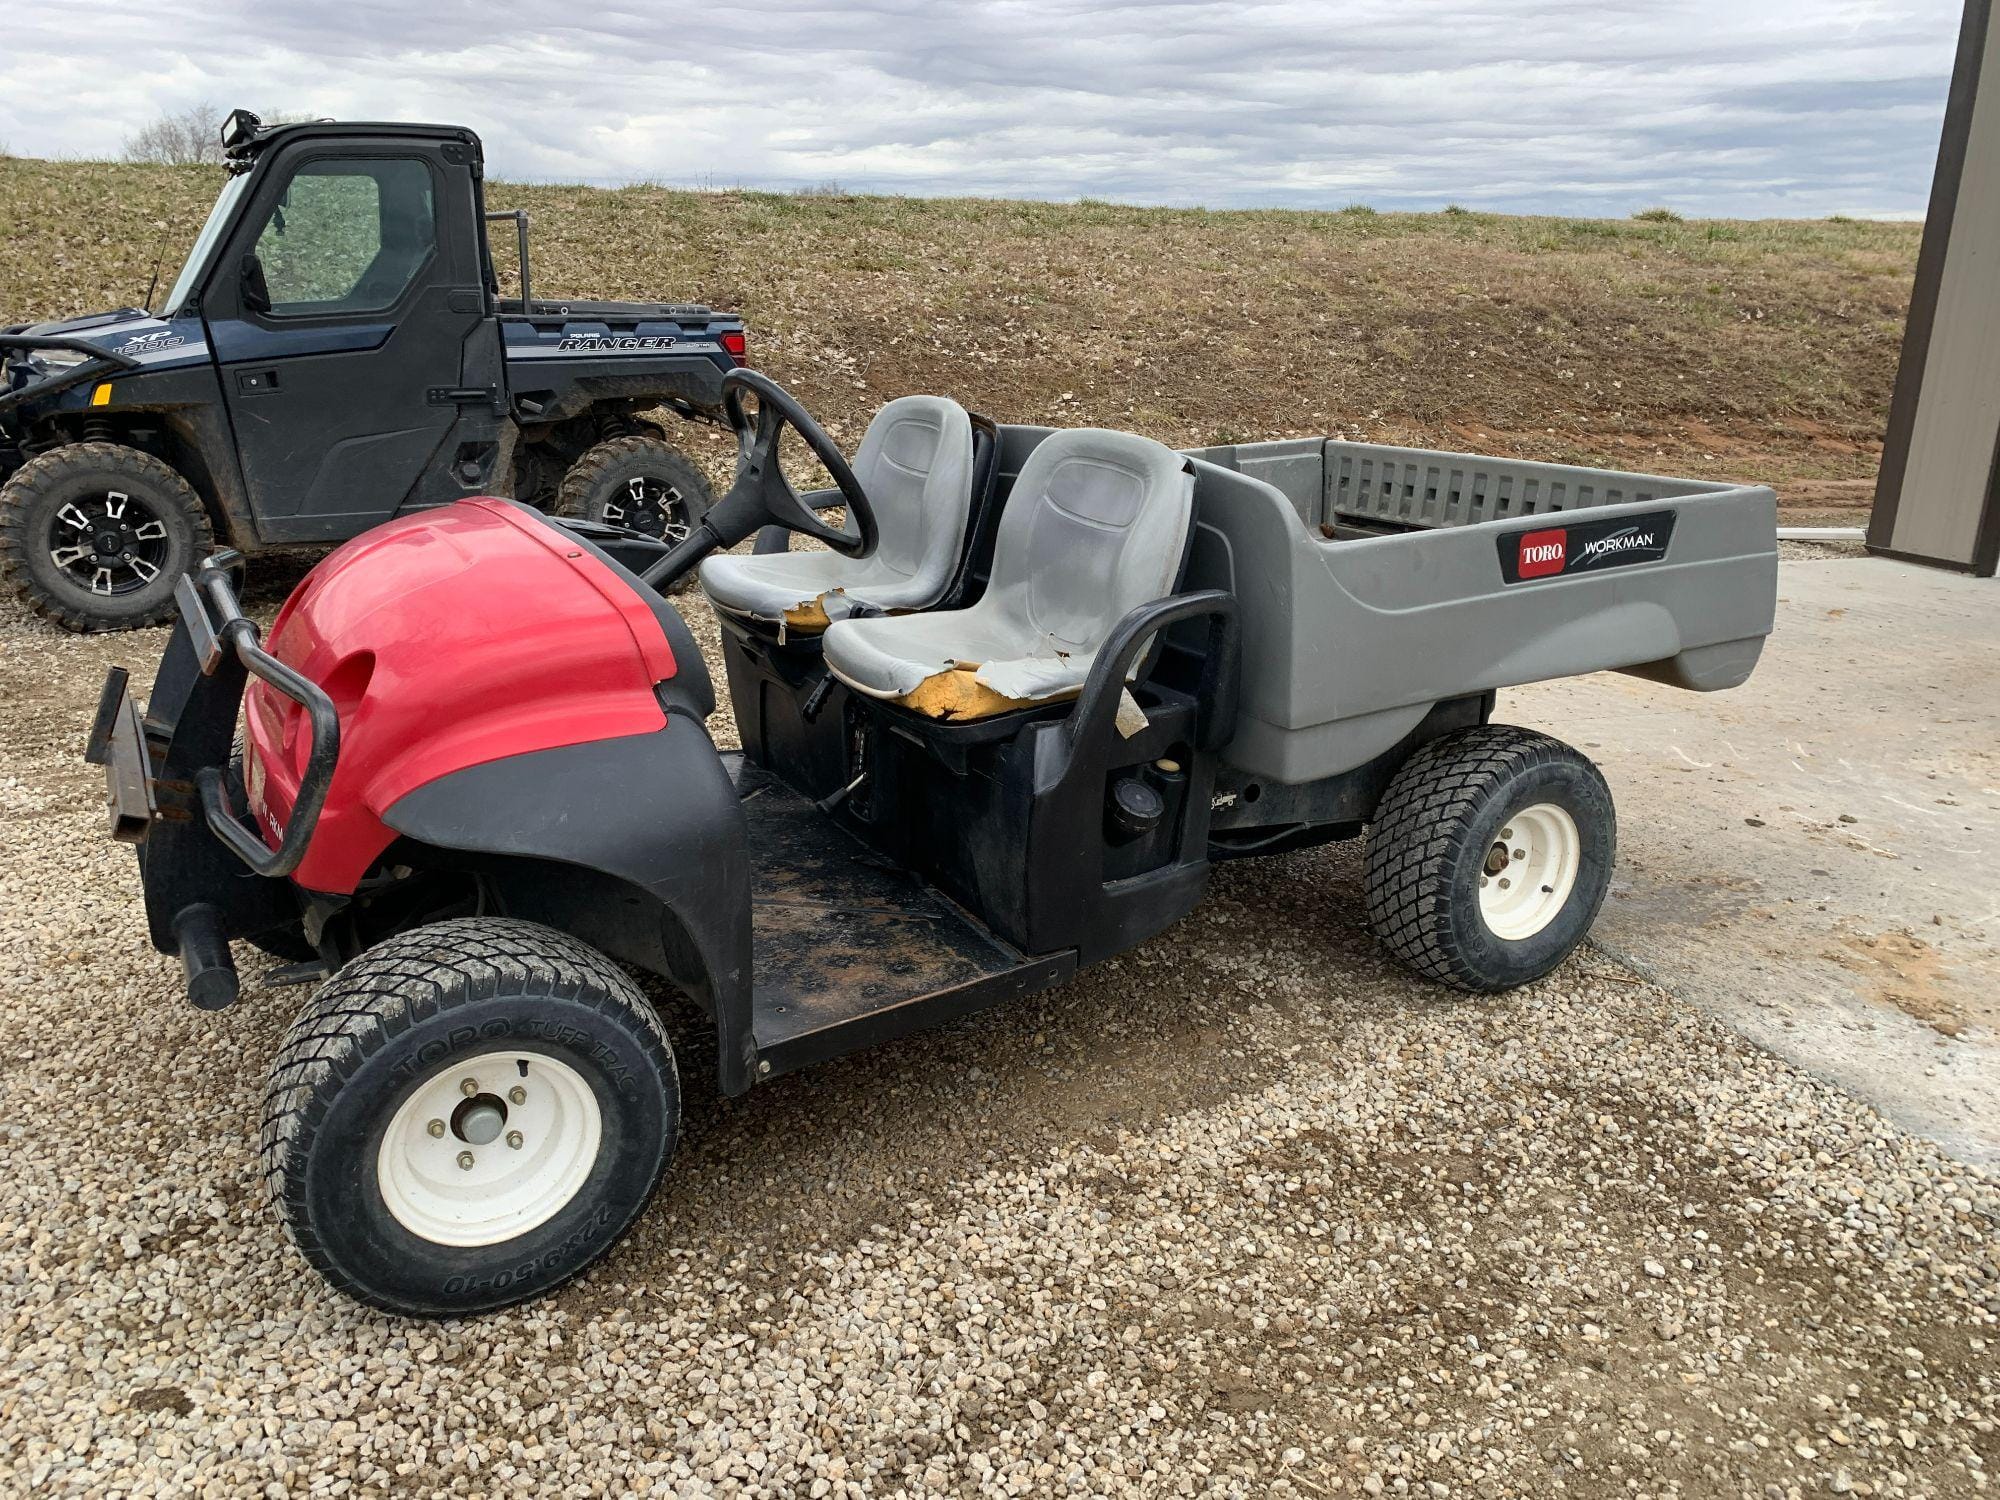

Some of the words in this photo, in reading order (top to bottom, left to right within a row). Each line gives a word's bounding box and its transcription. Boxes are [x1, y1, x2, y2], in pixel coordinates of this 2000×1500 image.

[113, 336, 184, 356] 1000
[125, 331, 172, 346] XP
[557, 337, 676, 352] RANGER
[1523, 543, 1563, 564] TORO
[1584, 534, 1653, 554] WORKMAN
[530, 1019, 589, 1045] TUFF
[591, 1040, 639, 1092] TRAC
